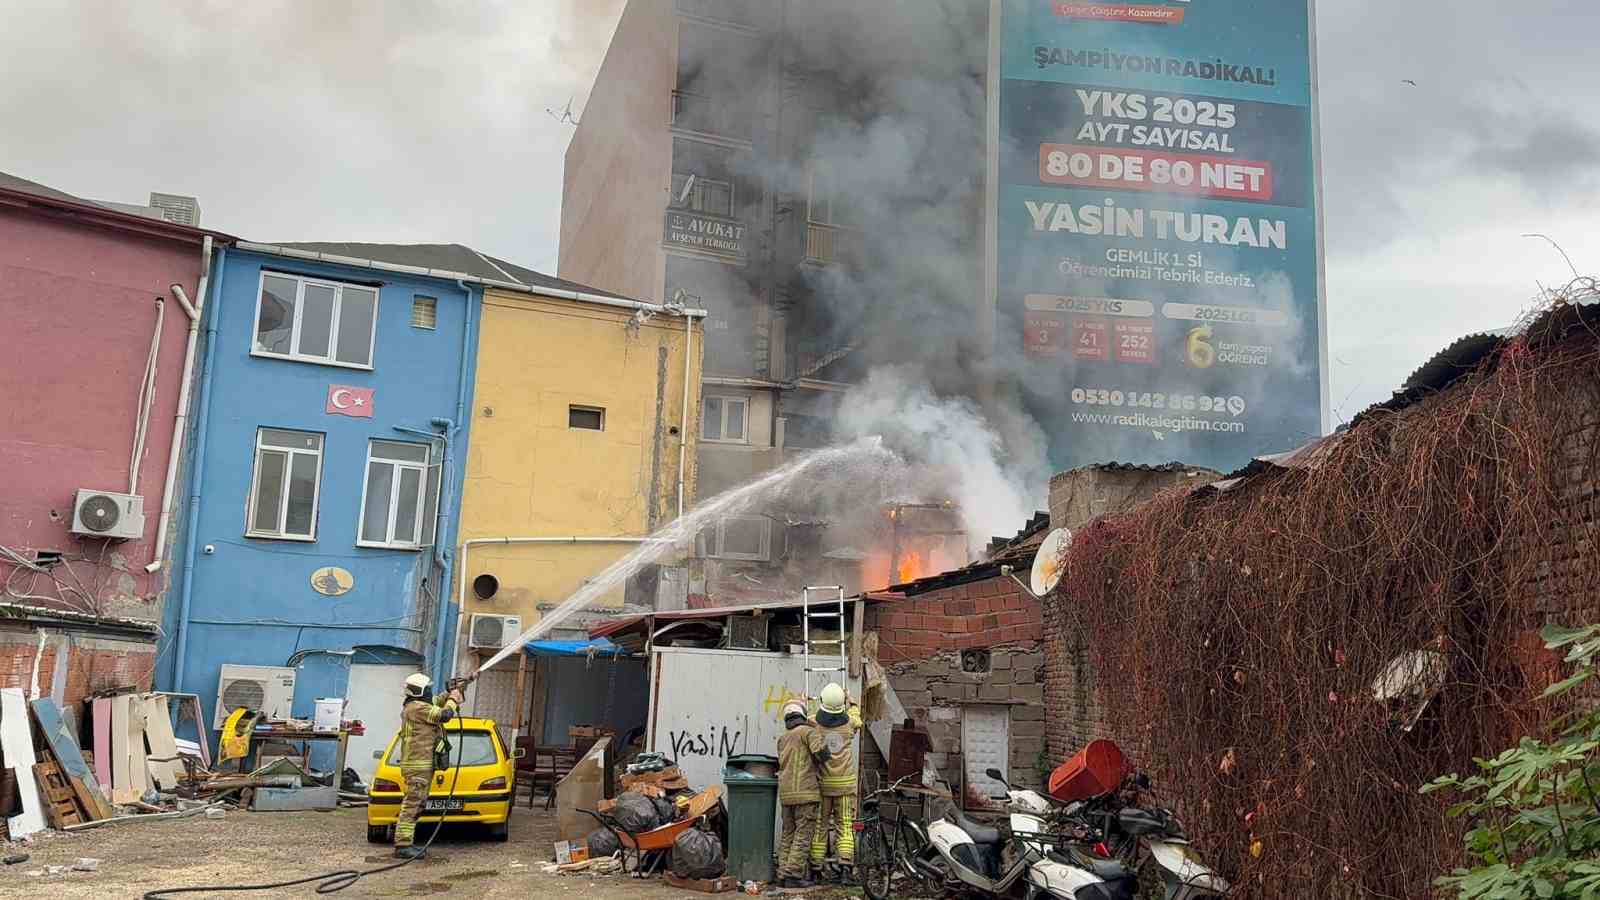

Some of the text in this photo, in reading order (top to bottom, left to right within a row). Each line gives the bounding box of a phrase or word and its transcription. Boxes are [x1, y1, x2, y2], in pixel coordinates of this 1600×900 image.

[1034, 46, 1274, 86] ŞAMPİYON RADİKAL!
[1076, 89, 1237, 129] YKS 2025
[1076, 121, 1235, 153] AYT SAYISAL
[1046, 151, 1265, 192] 80 DE 80 NET
[688, 219, 744, 239] AVUKAT
[1025, 198, 1287, 250] YASİN TURAN
[1105, 248, 1169, 265] GEMLİK
[1153, 266, 1201, 284] Tebrik
[1039, 329, 1049, 343] 3
[1079, 332, 1097, 346] 41
[1120, 335, 1149, 349] 252
[1187, 326, 1215, 367] 6
[1071, 387, 1124, 406] 0530
[1199, 395, 1226, 412] 92
[1071, 411, 1244, 433] www.radikalegitim.com
